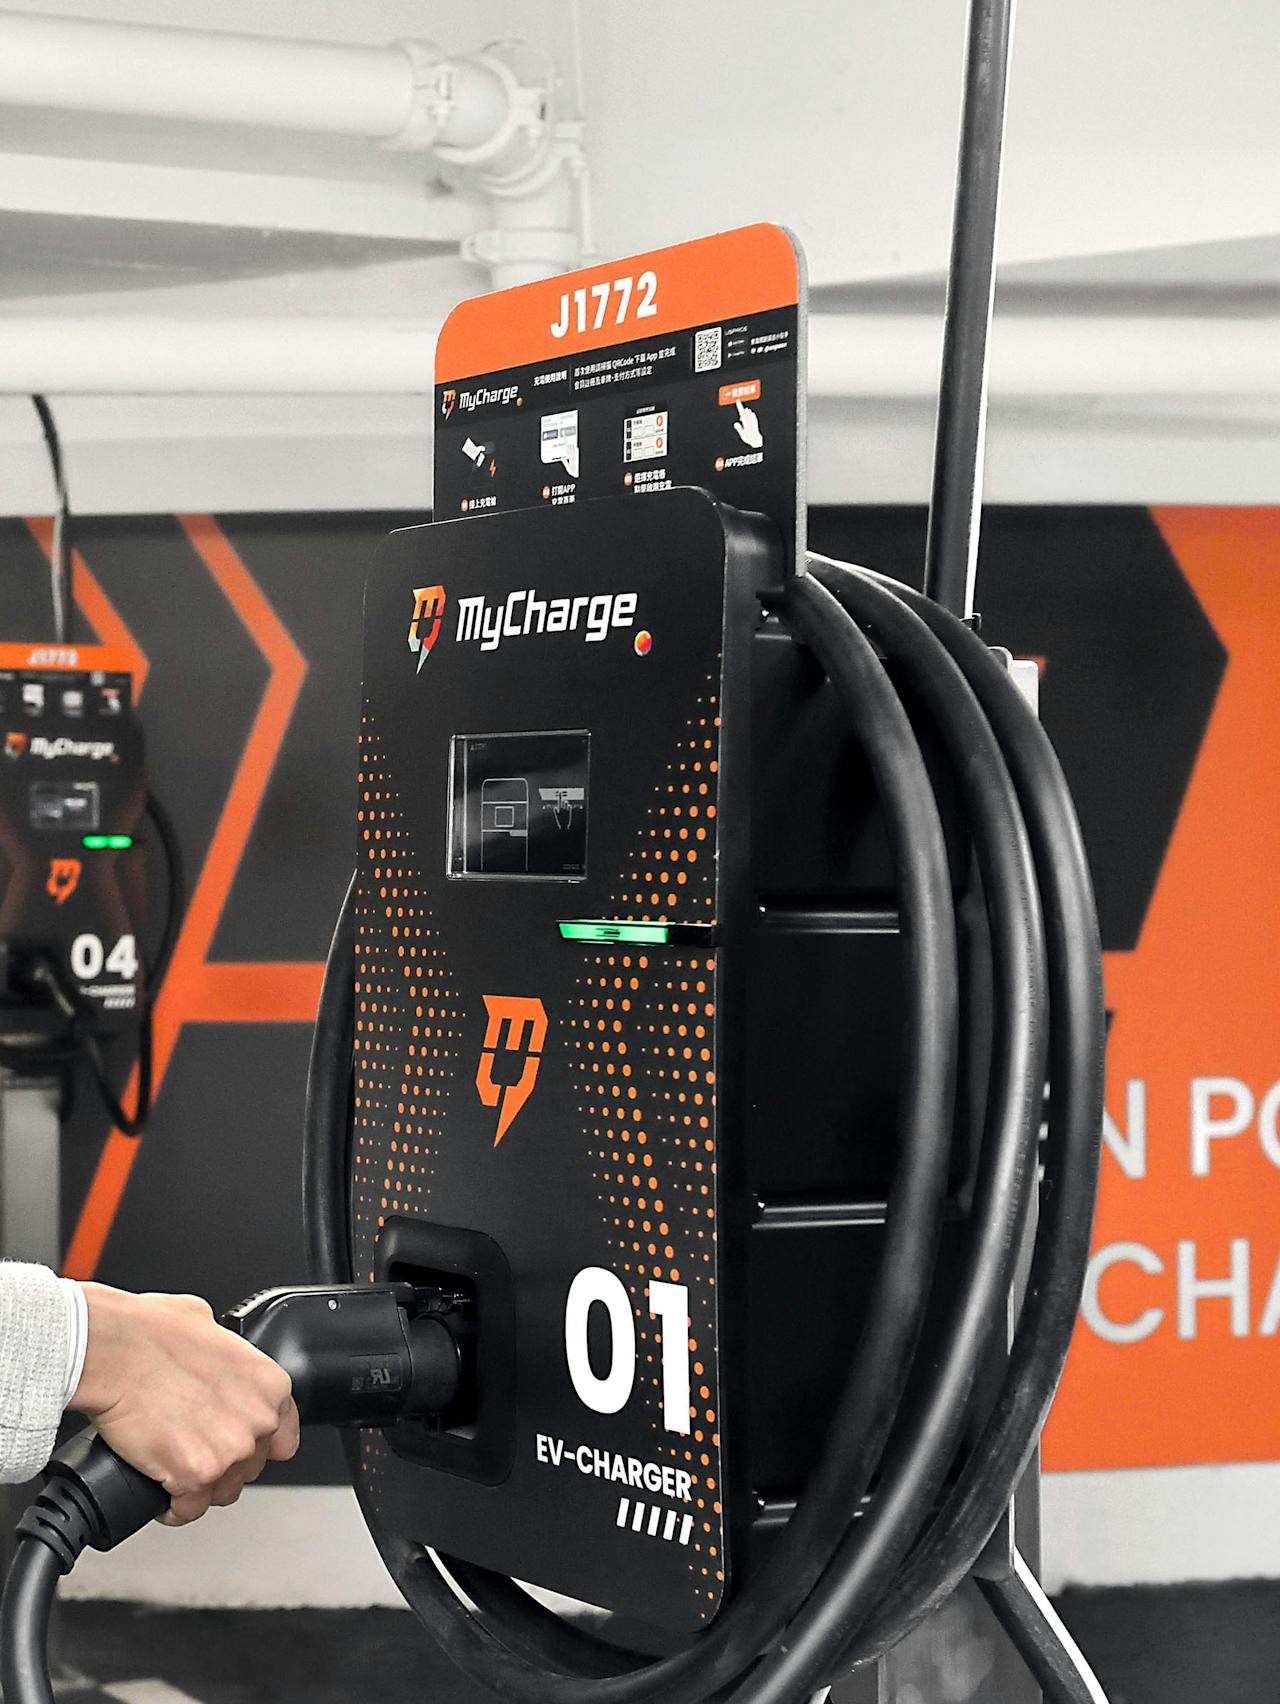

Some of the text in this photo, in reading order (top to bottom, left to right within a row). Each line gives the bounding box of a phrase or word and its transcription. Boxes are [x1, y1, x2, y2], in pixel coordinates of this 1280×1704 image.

[550, 271, 657, 338] J1772
[459, 386, 518, 411] MyCharge
[455, 589, 638, 651] MyCharge
[70, 933, 138, 980] 04
[1190, 1076, 1280, 1178] P
[1080, 1238, 1280, 1343] CH
[565, 1266, 691, 1435] 01
[535, 1433, 692, 1501] EV-CHARGER
